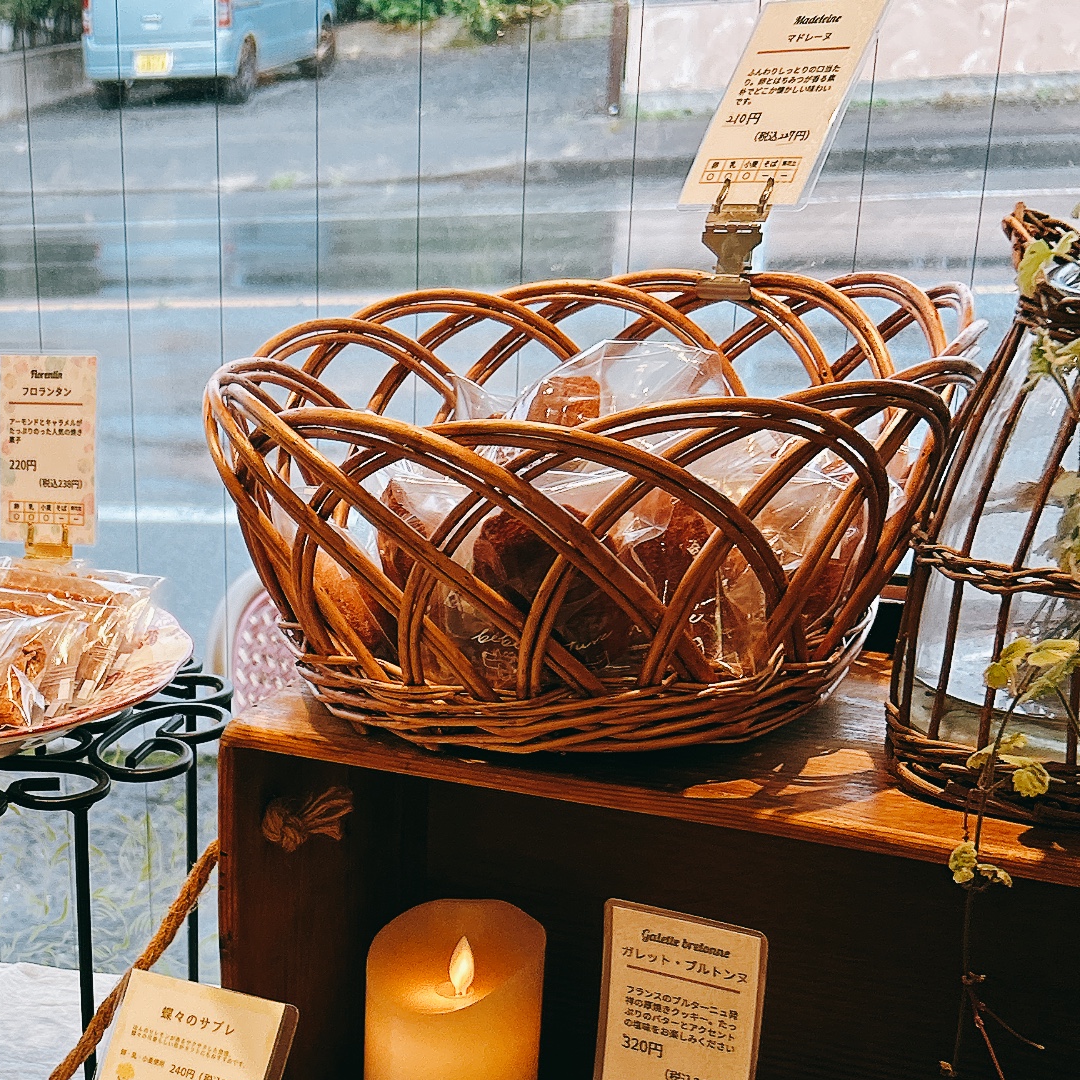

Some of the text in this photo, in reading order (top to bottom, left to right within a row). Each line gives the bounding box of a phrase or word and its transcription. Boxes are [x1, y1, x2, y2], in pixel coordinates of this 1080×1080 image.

[787, 32, 832, 42] マドレーヌ
[735, 98, 752, 106] です。
[725, 112, 763, 125] 210円
[22, 387, 72, 397] フロランタン
[9, 459, 37, 472] 220円
[621, 945, 749, 985] ガレット・ブルトンヌ
[626, 985, 739, 1021] フランスのブルターニュ発
[160, 1006, 236, 1036] 蝶々のサブレ
[624, 1007, 735, 1042] ぷりのバターとアクセント
[621, 1035, 664, 1059] 320円
[623, 1018, 735, 1053] の塩味をお楽しみください
